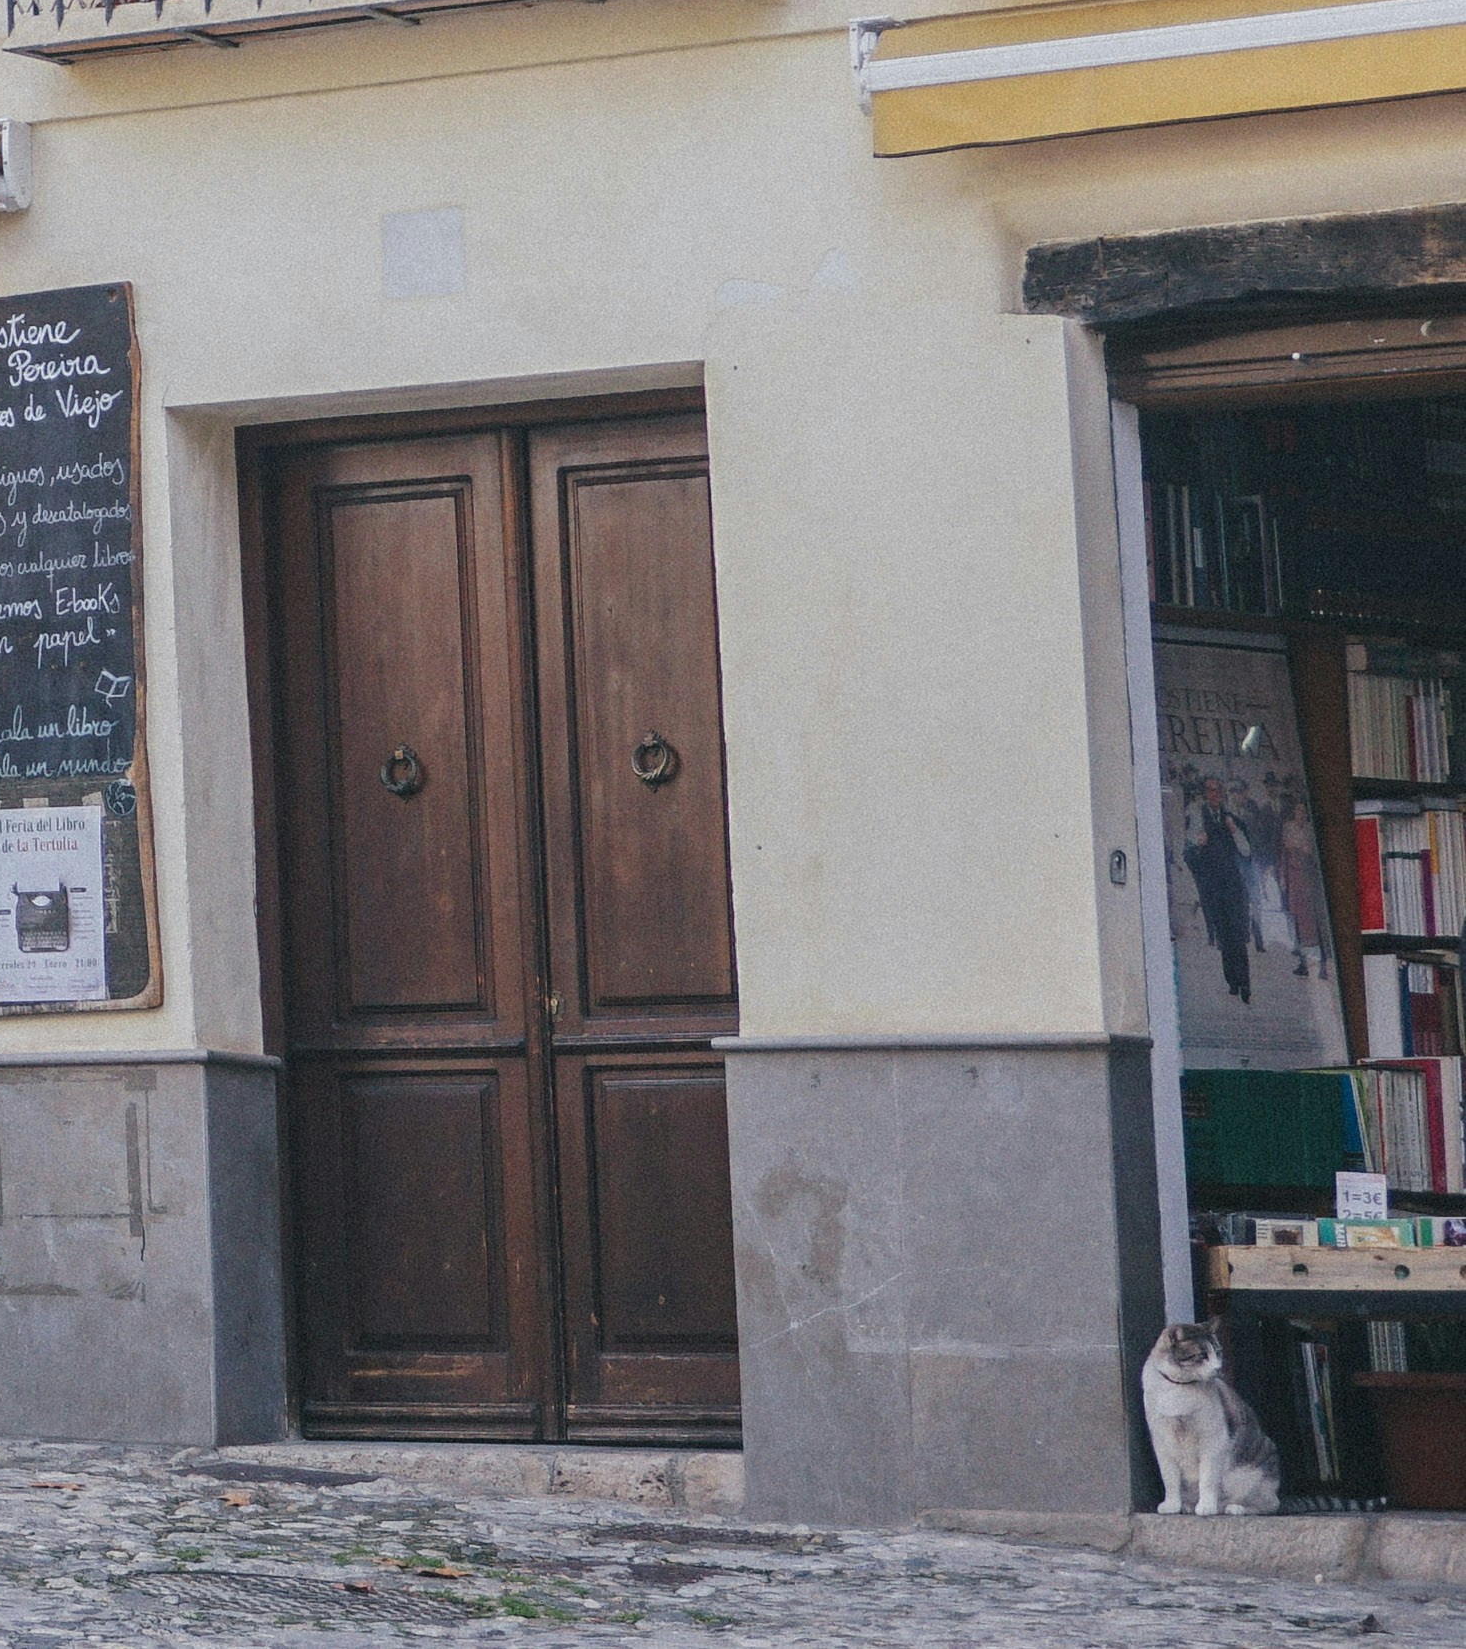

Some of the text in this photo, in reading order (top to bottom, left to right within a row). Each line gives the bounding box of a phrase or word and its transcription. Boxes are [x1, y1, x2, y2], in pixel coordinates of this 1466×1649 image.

[7, 349, 111, 387] Pereira
[23, 393, 47, 422] de
[55, 384, 124, 429] Viejo
[10, 510, 28, 548] y
[32, 499, 133, 536] descatalogados
[37, 720, 64, 739] un
[65, 704, 120, 737] libro
[25, 763, 53, 778] un
[57, 738, 133, 778] mundo
[5, 818, 35, 834] Feria
[36, 816, 52, 832] del
[56, 816, 86, 832] Libro
[2, 836, 79, 854] de La Tertulia
